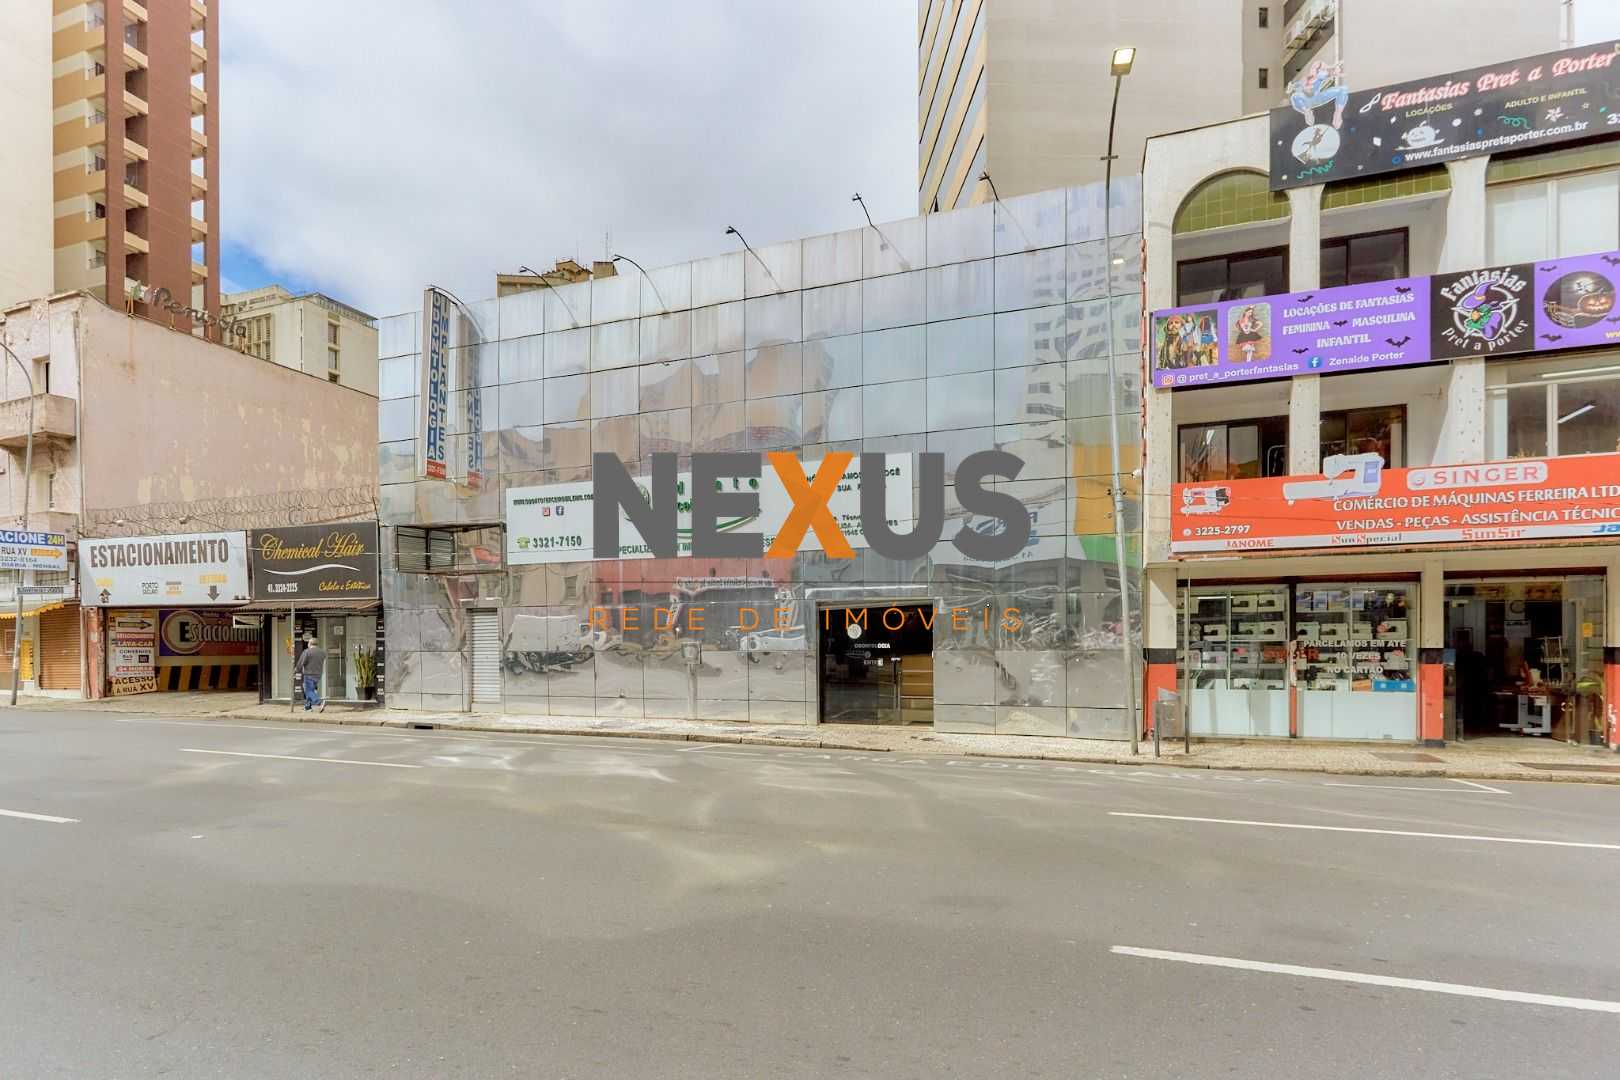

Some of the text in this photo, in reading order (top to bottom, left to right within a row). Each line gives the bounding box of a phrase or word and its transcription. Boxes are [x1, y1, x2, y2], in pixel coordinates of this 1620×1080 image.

[1382, 52, 1616, 111] Fantasias Pret a Porter
[1405, 103, 1453, 118] LOCAÇÕES
[1504, 95, 1540, 109] ADULTO
[1541, 94, 1547, 102] E
[1405, 120, 1589, 161] www.fantasiaspretaporter.com.br
[1283, 293, 1415, 318] LOCAÇÕES DE FANTASIAS
[1283, 312, 1416, 335] FEMININA MASCULINA
[1317, 334, 1371, 348] INFANTIL
[1328, 352, 1405, 366] Zenaide Porter
[427, 292, 441, 460] ODONTOLOGIA
[436, 298, 449, 461] IMPLANTES
[1434, 466, 1538, 486] SINGER
[1334, 485, 1620, 511] COMÉRCIO DE MÁQUINAS FERREIRA LTD
[1336, 506, 1620, 530] VENDAS PEÇAS ASSISTÊNCIA TÉCNIC
[48, 535, 64, 545] 24H
[1195, 525, 1251, 536] 3225-2797
[260, 531, 365, 560] Chemical Hair
[532, 535, 582, 548] 3321-7150
[1225, 539, 1275, 548] JANOME
[17, 548, 27, 556] XV
[90, 538, 229, 568] ESTACIONAMENTO
[1303, 639, 1367, 648] PARCELAMOS
[1370, 639, 1385, 647] EM
[115, 675, 154, 685] ACESSO
[1327, 666, 1340, 674] NO
[139, 682, 155, 690] XV
